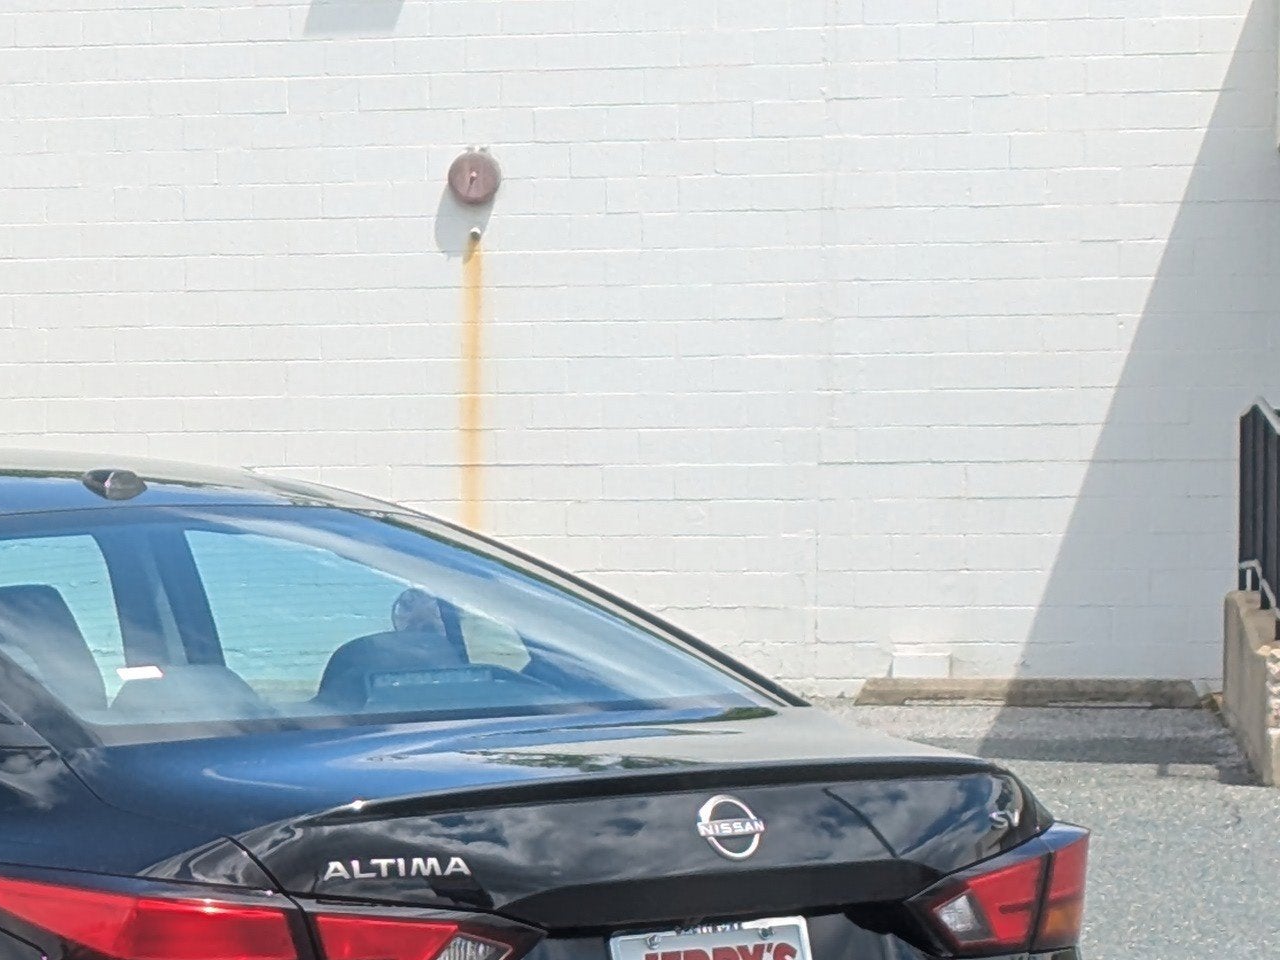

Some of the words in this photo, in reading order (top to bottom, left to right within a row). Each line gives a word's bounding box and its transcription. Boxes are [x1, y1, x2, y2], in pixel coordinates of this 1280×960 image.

[698, 820, 765, 837] NISSAN
[991, 810, 1020, 829] SV
[322, 856, 472, 882] ALTIMA
